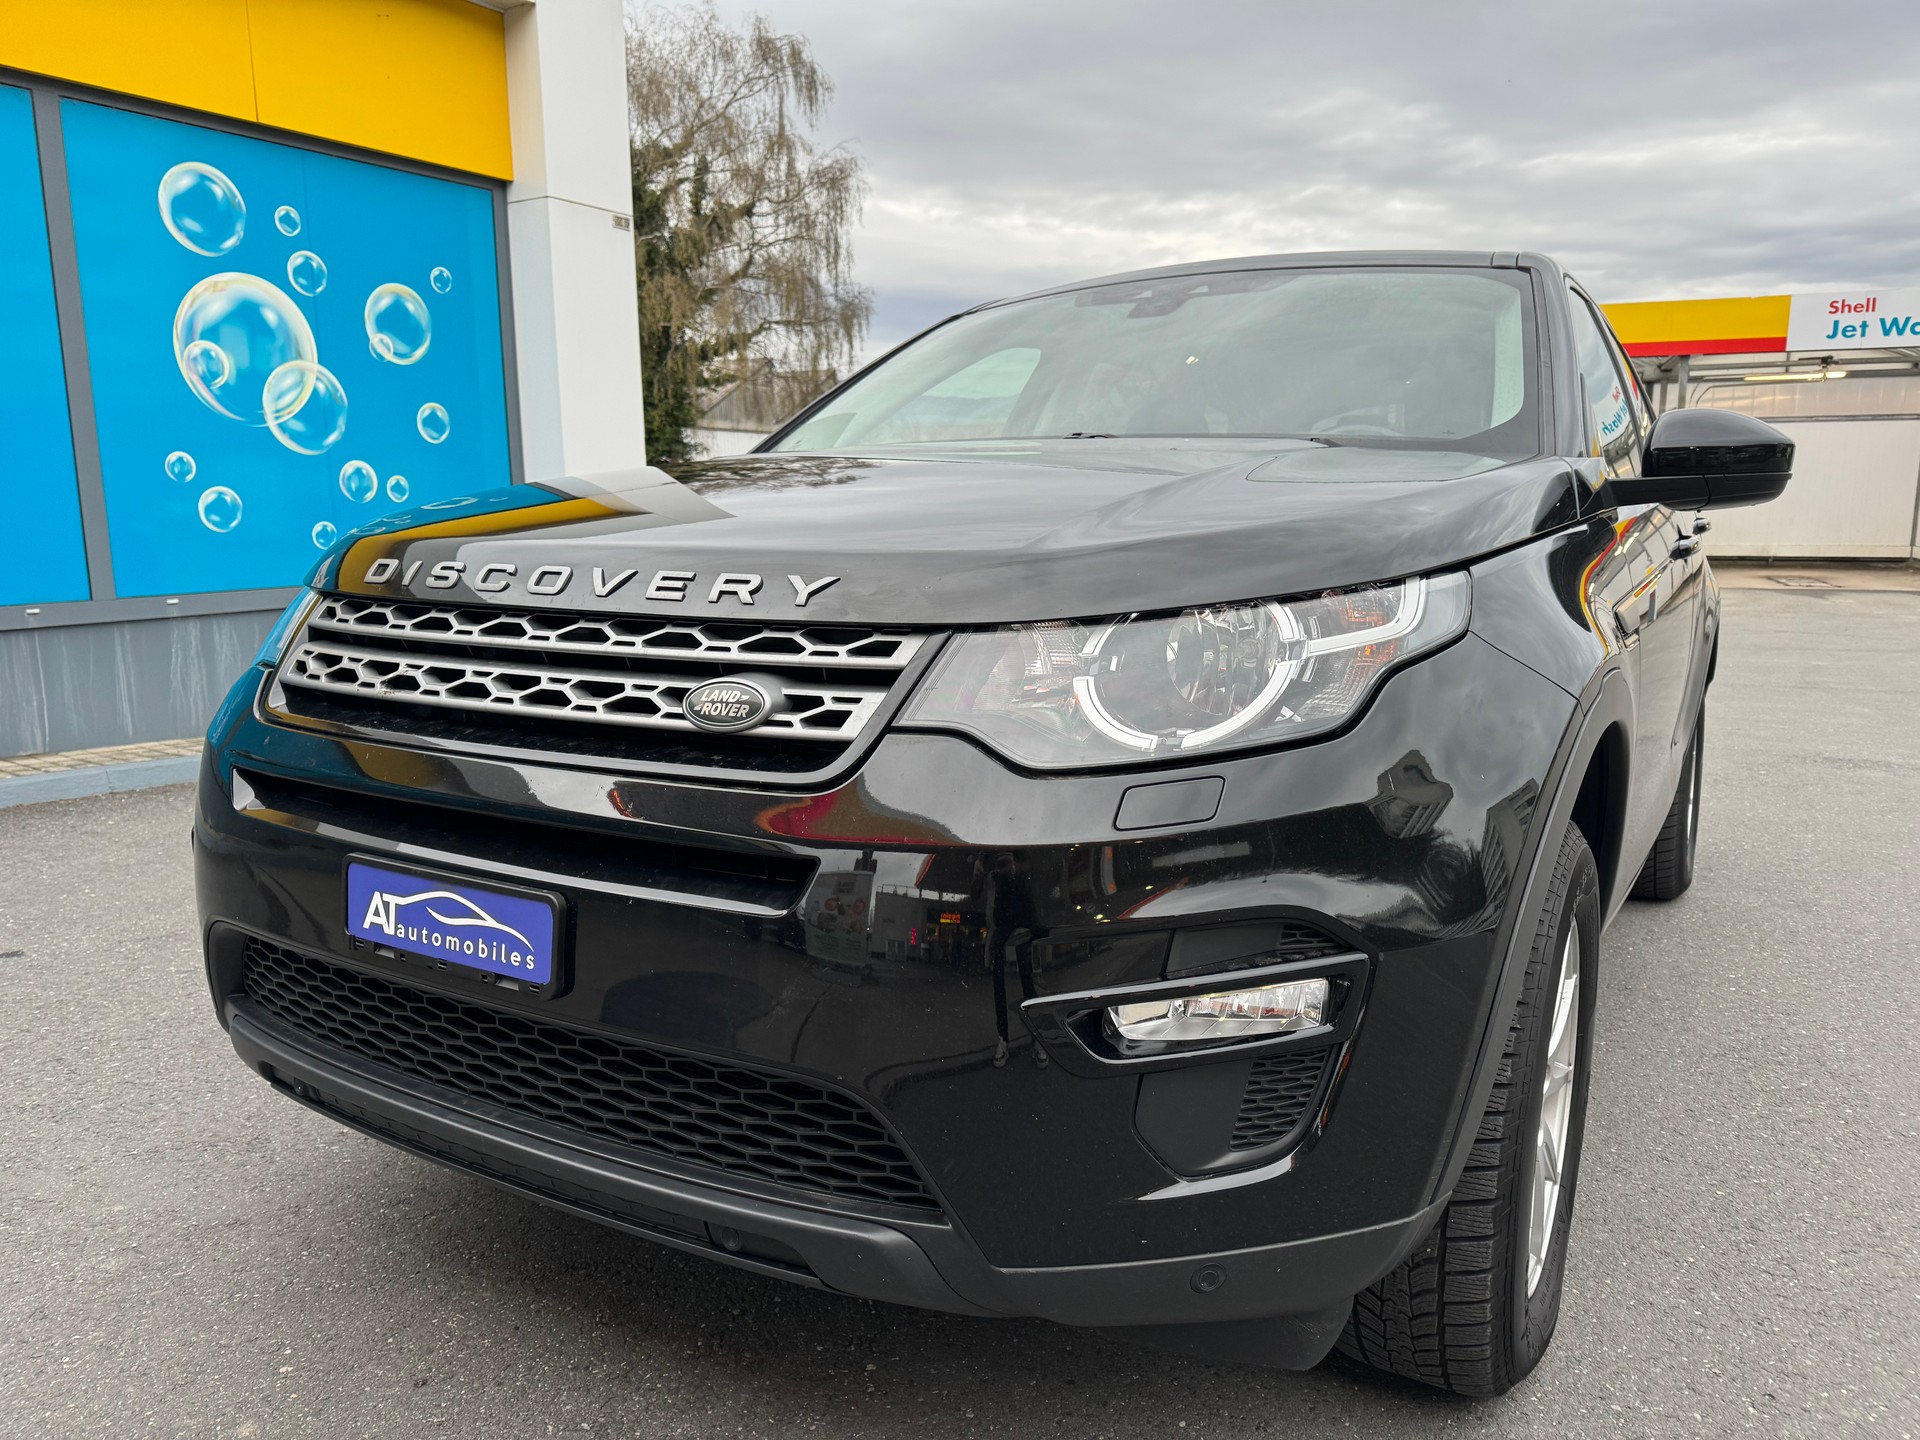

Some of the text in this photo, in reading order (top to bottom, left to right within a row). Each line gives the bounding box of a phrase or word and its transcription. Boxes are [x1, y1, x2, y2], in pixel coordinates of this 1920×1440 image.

[1828, 297, 1877, 315] Shell
[1825, 319, 1869, 340] Jet
[363, 558, 841, 607] DISCOVERY
[700, 689, 742, 703] LAND
[700, 702, 750, 718] ROVER
[362, 891, 402, 936] AT
[396, 924, 535, 970] automobiles
